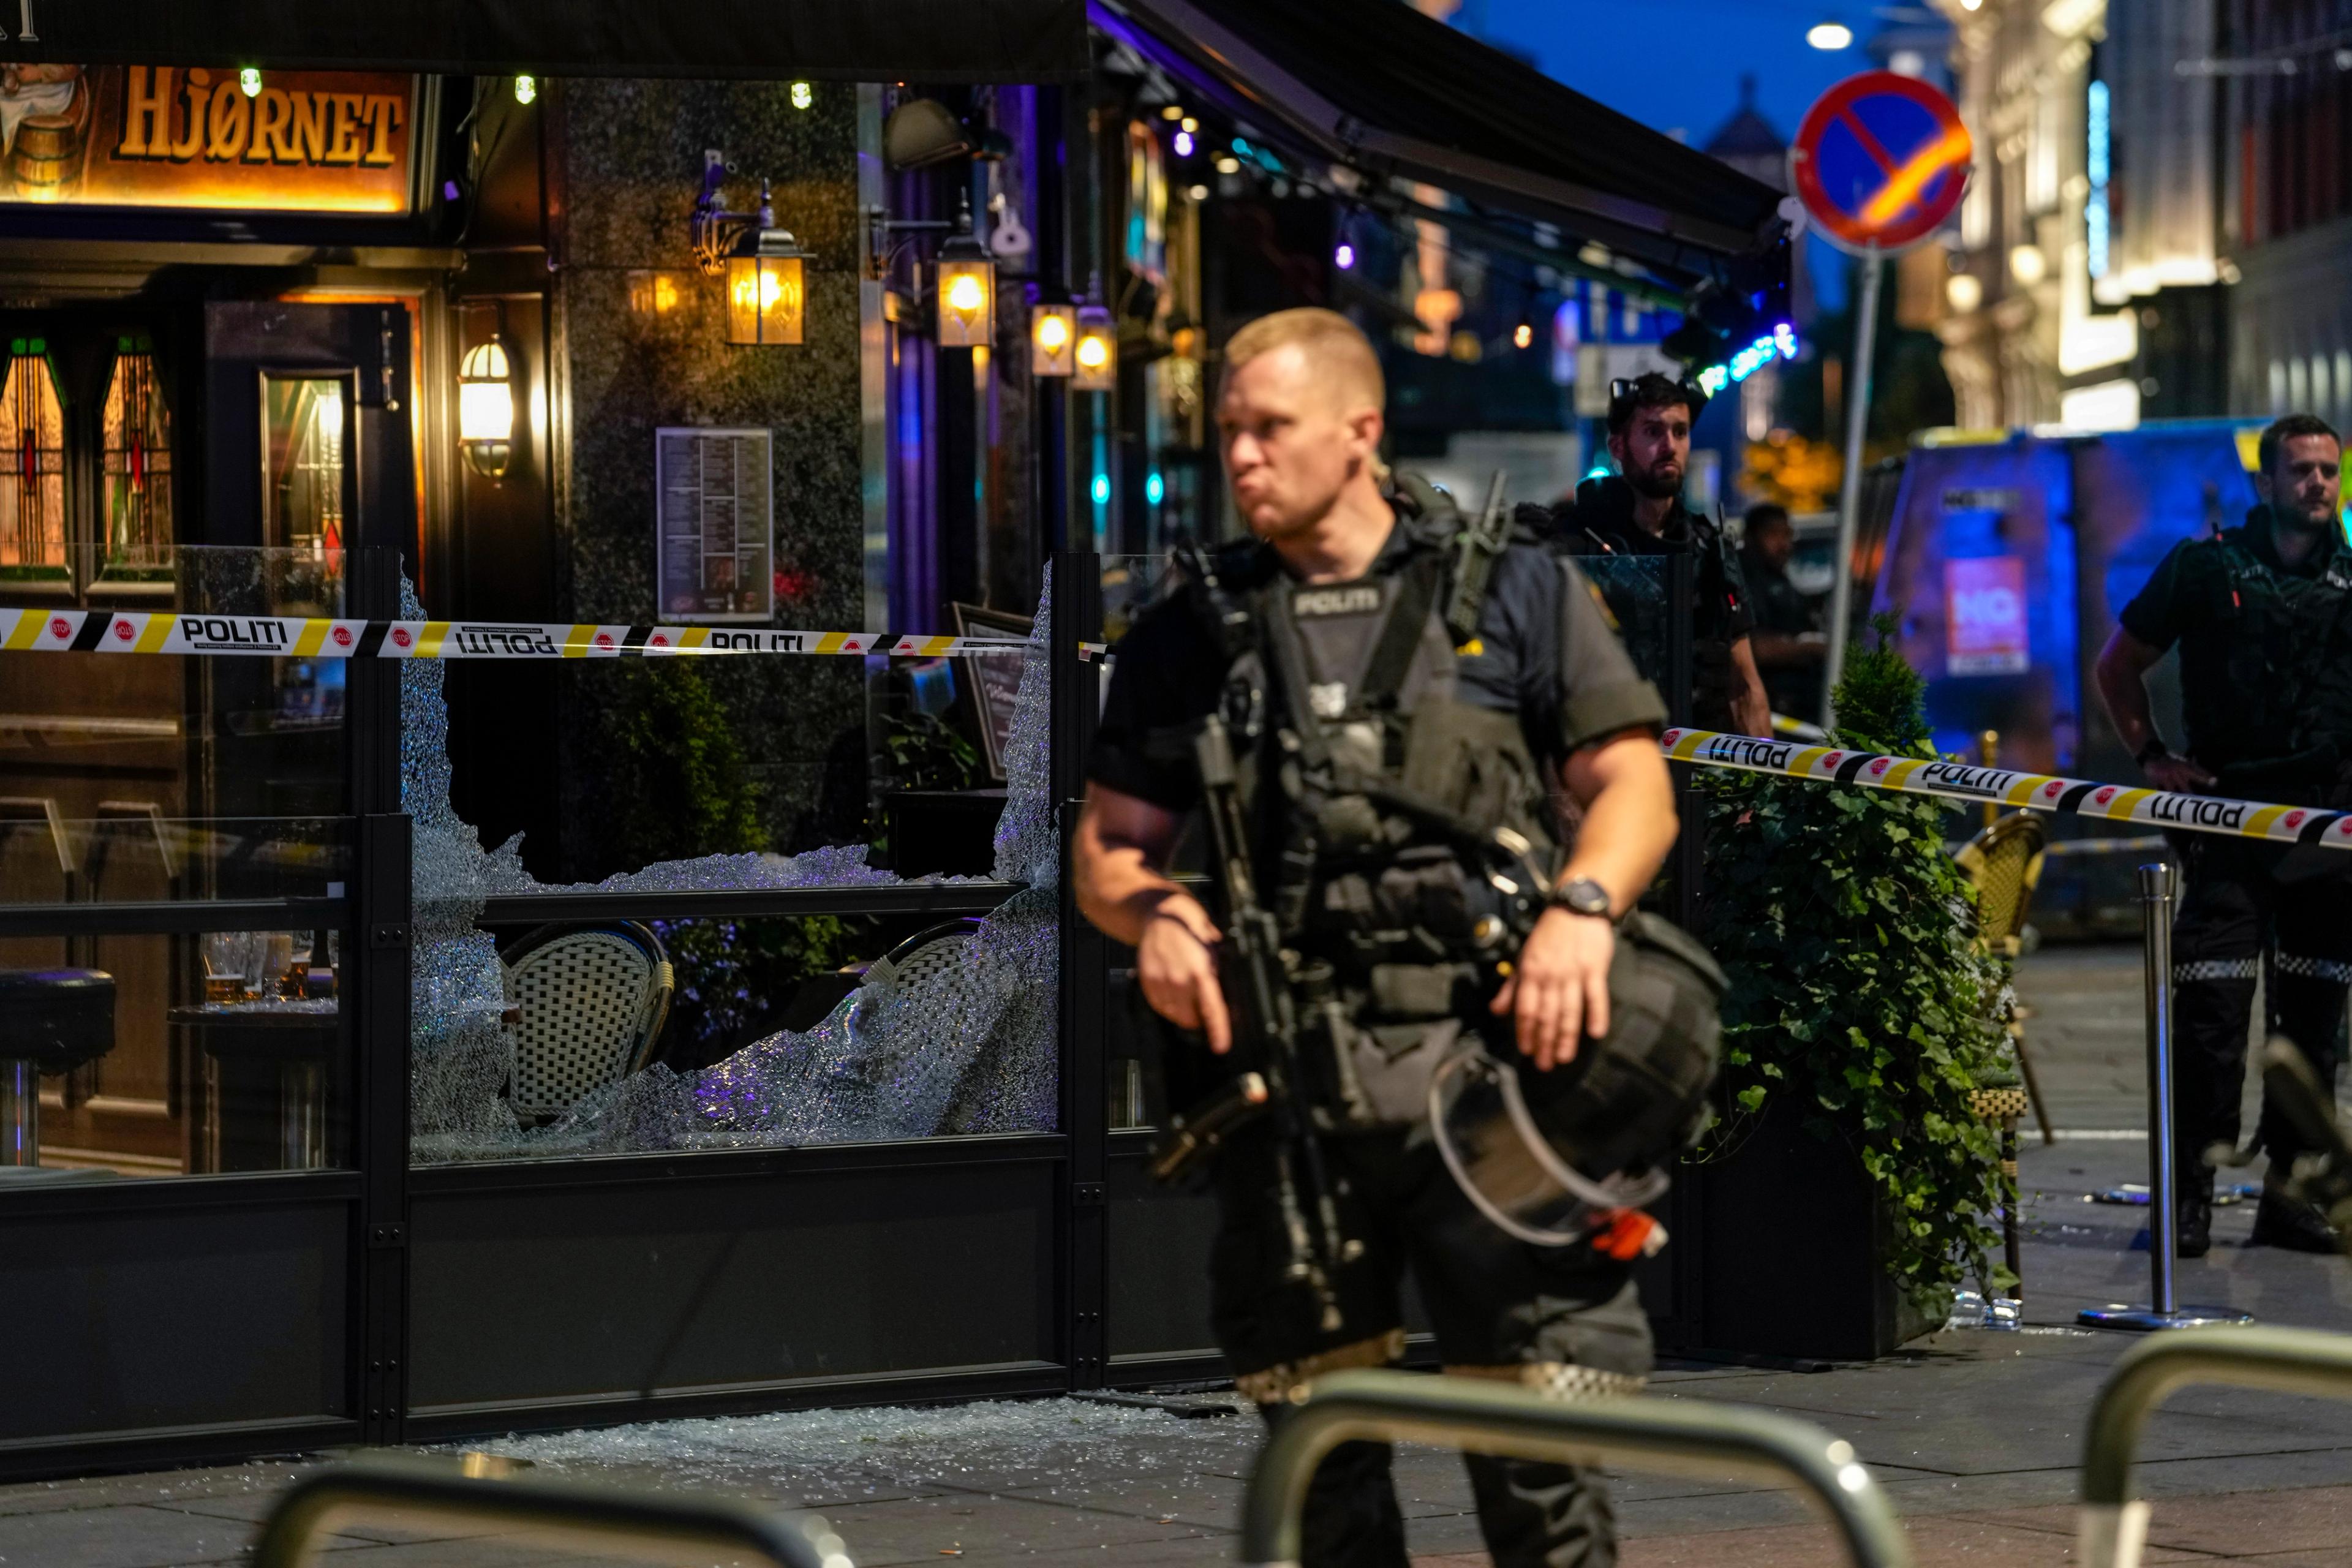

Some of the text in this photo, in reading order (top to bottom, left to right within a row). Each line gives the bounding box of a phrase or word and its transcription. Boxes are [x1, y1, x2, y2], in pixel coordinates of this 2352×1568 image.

[53, 623, 70, 633] STOP
[116, 626, 133, 635] STOP
[181, 618, 288, 643] POLITI
[334, 632, 351, 641] STOP
[393, 633, 410, 643] STOP
[455, 633, 558, 654] POLITI
[1663, 733, 1678, 742] STOP
[1709, 737, 1792, 769] POLITI
[1921, 763, 2015, 790] POLITI
[2151, 795, 2246, 828] POLITI
